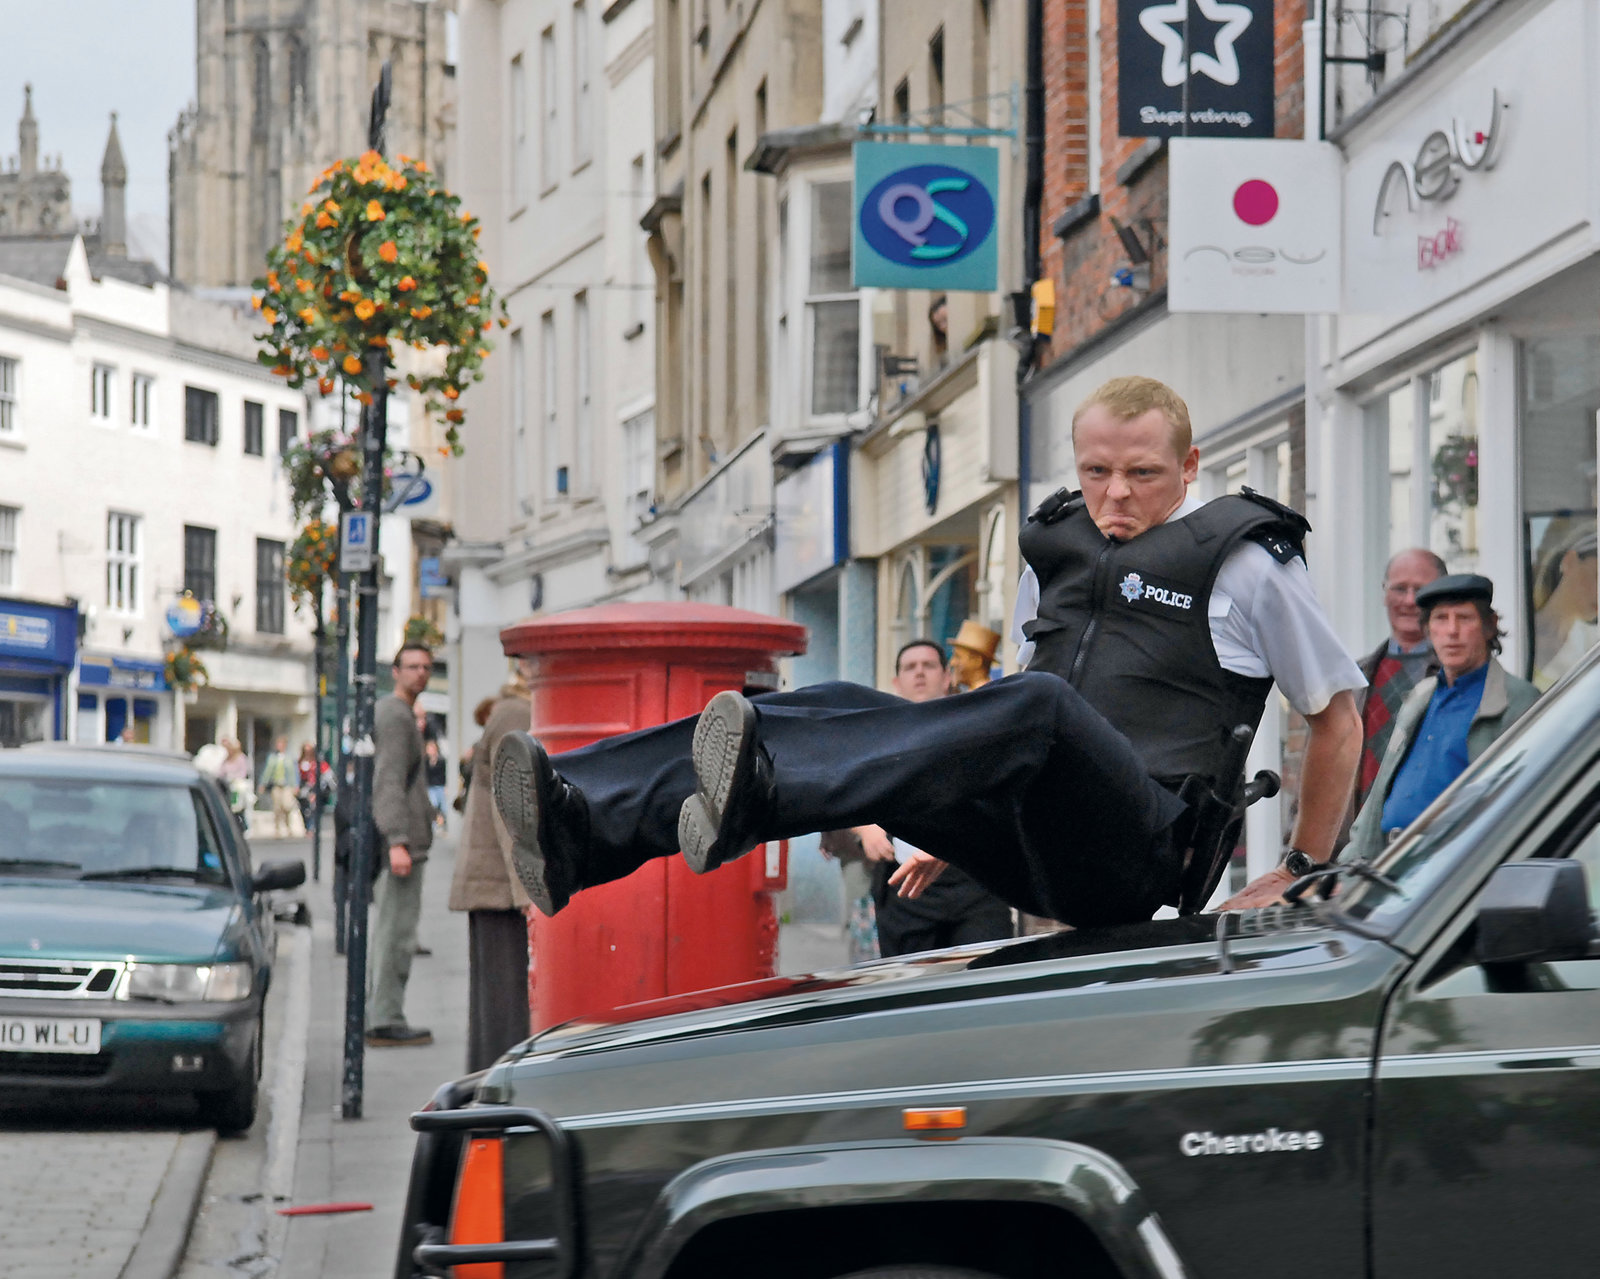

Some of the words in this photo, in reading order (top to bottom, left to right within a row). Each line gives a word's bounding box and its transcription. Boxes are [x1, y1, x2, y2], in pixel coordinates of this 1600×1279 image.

[878, 177, 969, 260] QS
[1145, 584, 1193, 610] POLICE
[35, 1024, 90, 1046] WLU
[1179, 1127, 1323, 1157] Cherokee
